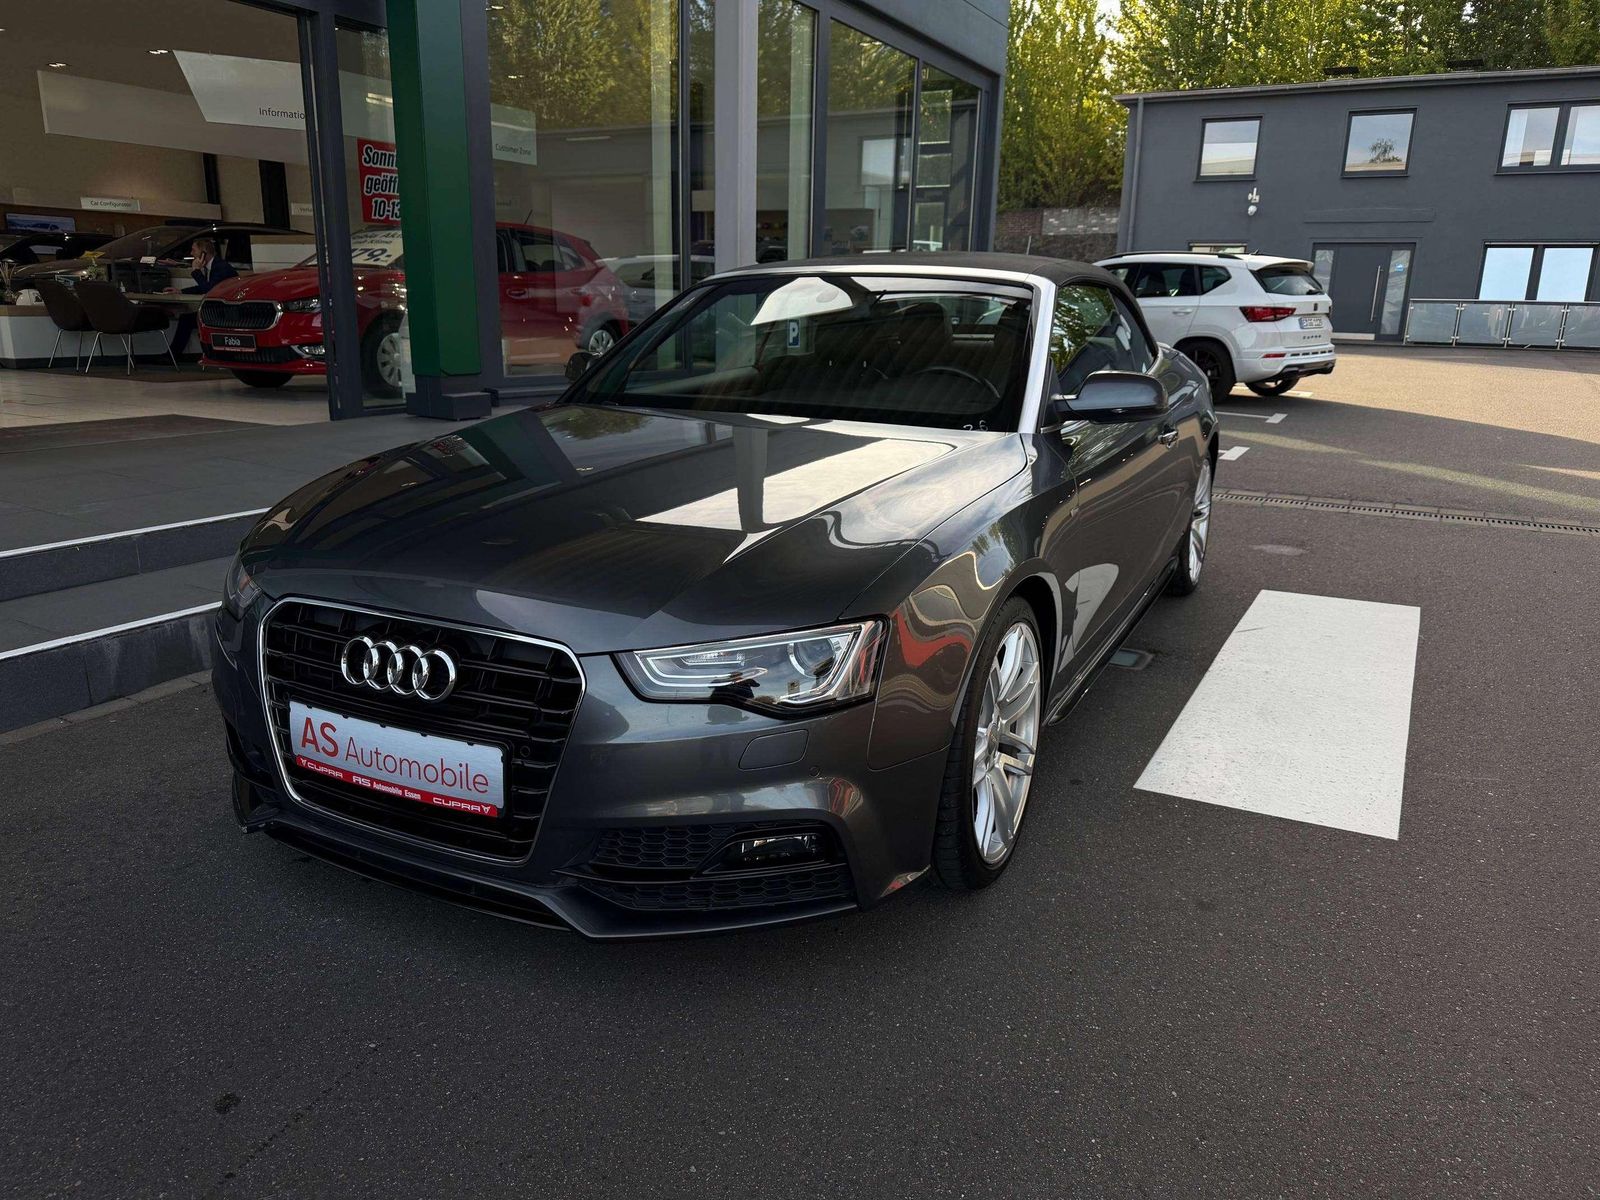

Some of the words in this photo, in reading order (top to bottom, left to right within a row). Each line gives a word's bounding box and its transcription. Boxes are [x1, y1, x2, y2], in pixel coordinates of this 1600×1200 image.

[259, 107, 305, 120] Informatio
[362, 144, 398, 170] Sonn
[364, 172, 400, 195] geöff
[224, 336, 241, 346] Fabia
[301, 716, 339, 757] AS
[345, 736, 489, 794] Automobile
[307, 763, 343, 779] CUPRA
[352, 775, 371, 787] AS
[373, 781, 402, 796] Automobile
[404, 789, 421, 800] Essen
[432, 797, 481, 812] CUPRA
